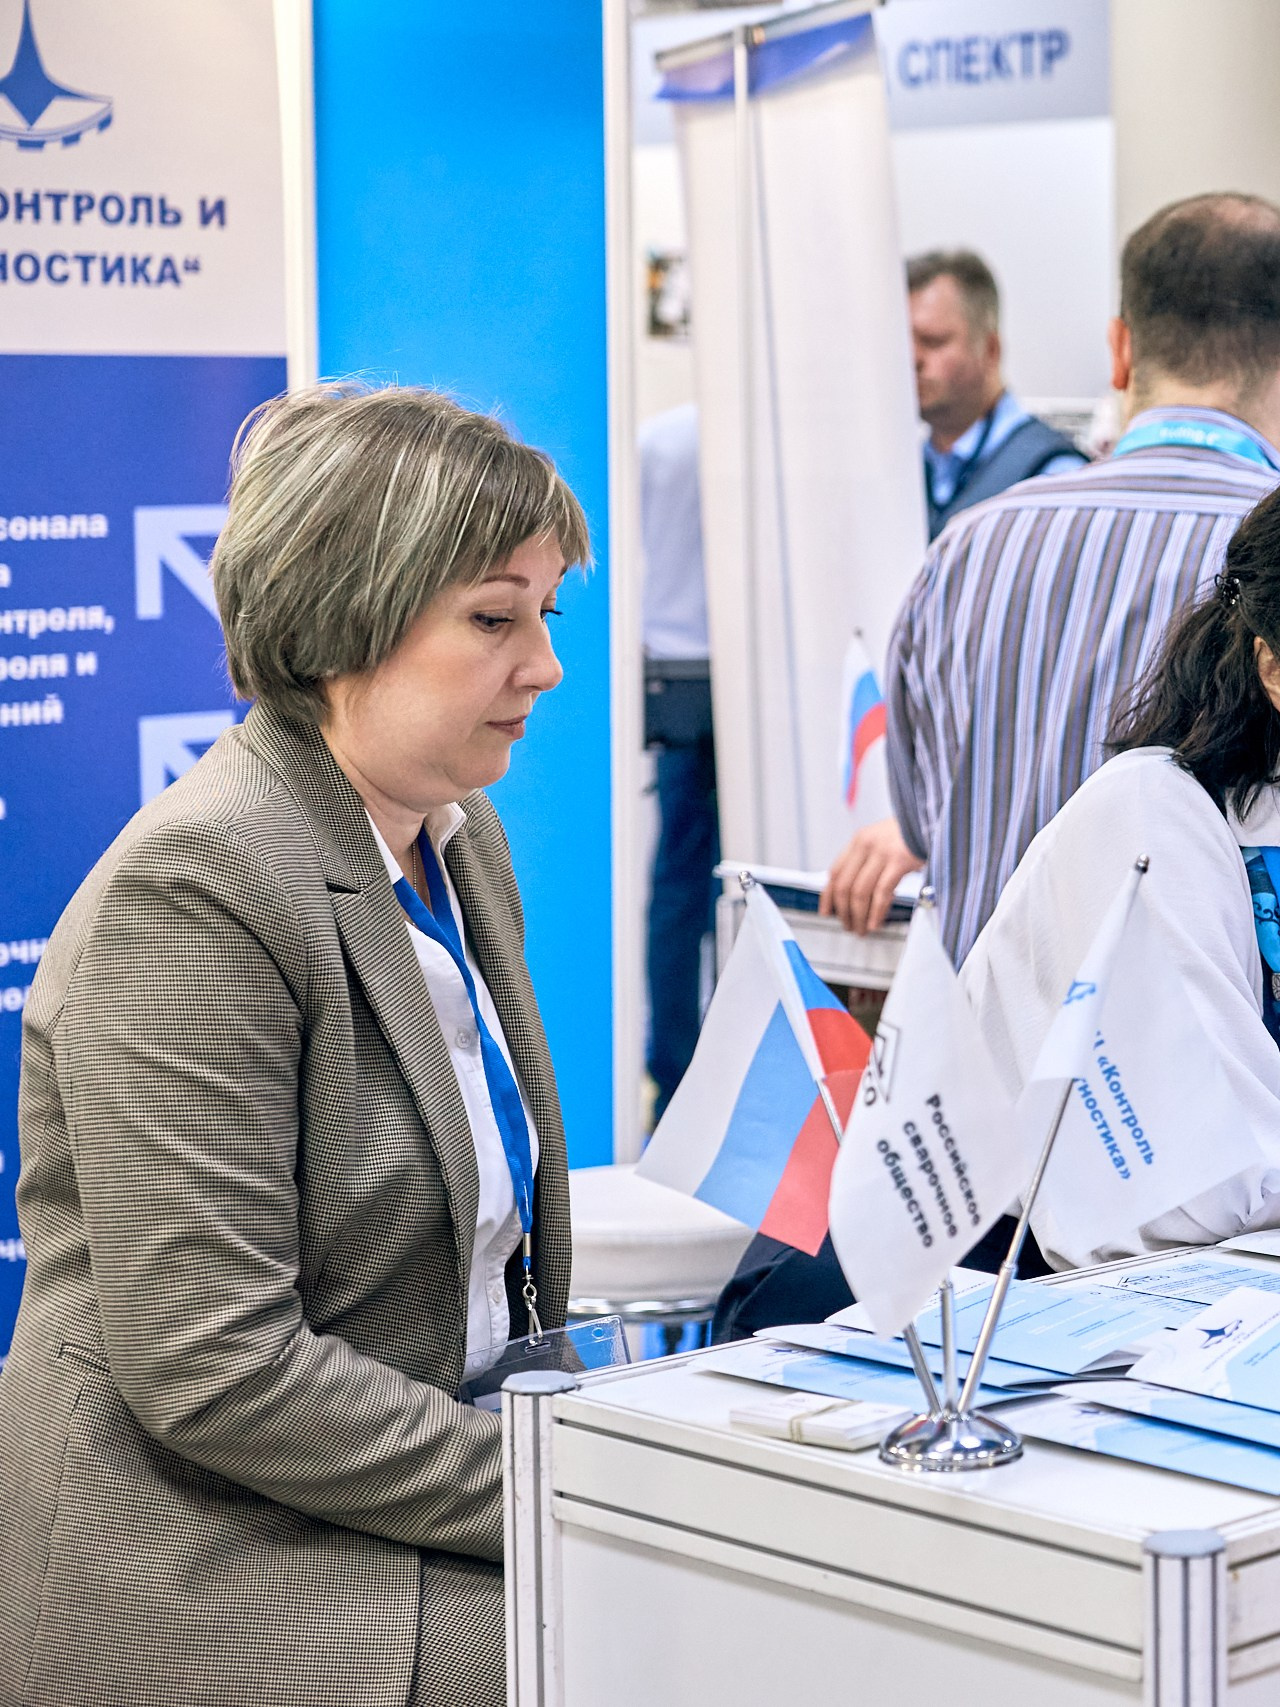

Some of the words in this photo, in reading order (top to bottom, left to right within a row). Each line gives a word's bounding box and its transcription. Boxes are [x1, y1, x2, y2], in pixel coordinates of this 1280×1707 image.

[898, 29, 1070, 87] СПЕКТР
[198, 196, 226, 229] И
[75, 651, 97, 676] и
[926, 1094, 980, 1227] Российское
[1097, 1056, 1154, 1165] «Контроль
[877, 1139, 934, 1249] общество
[903, 1121, 958, 1239] сварочное
